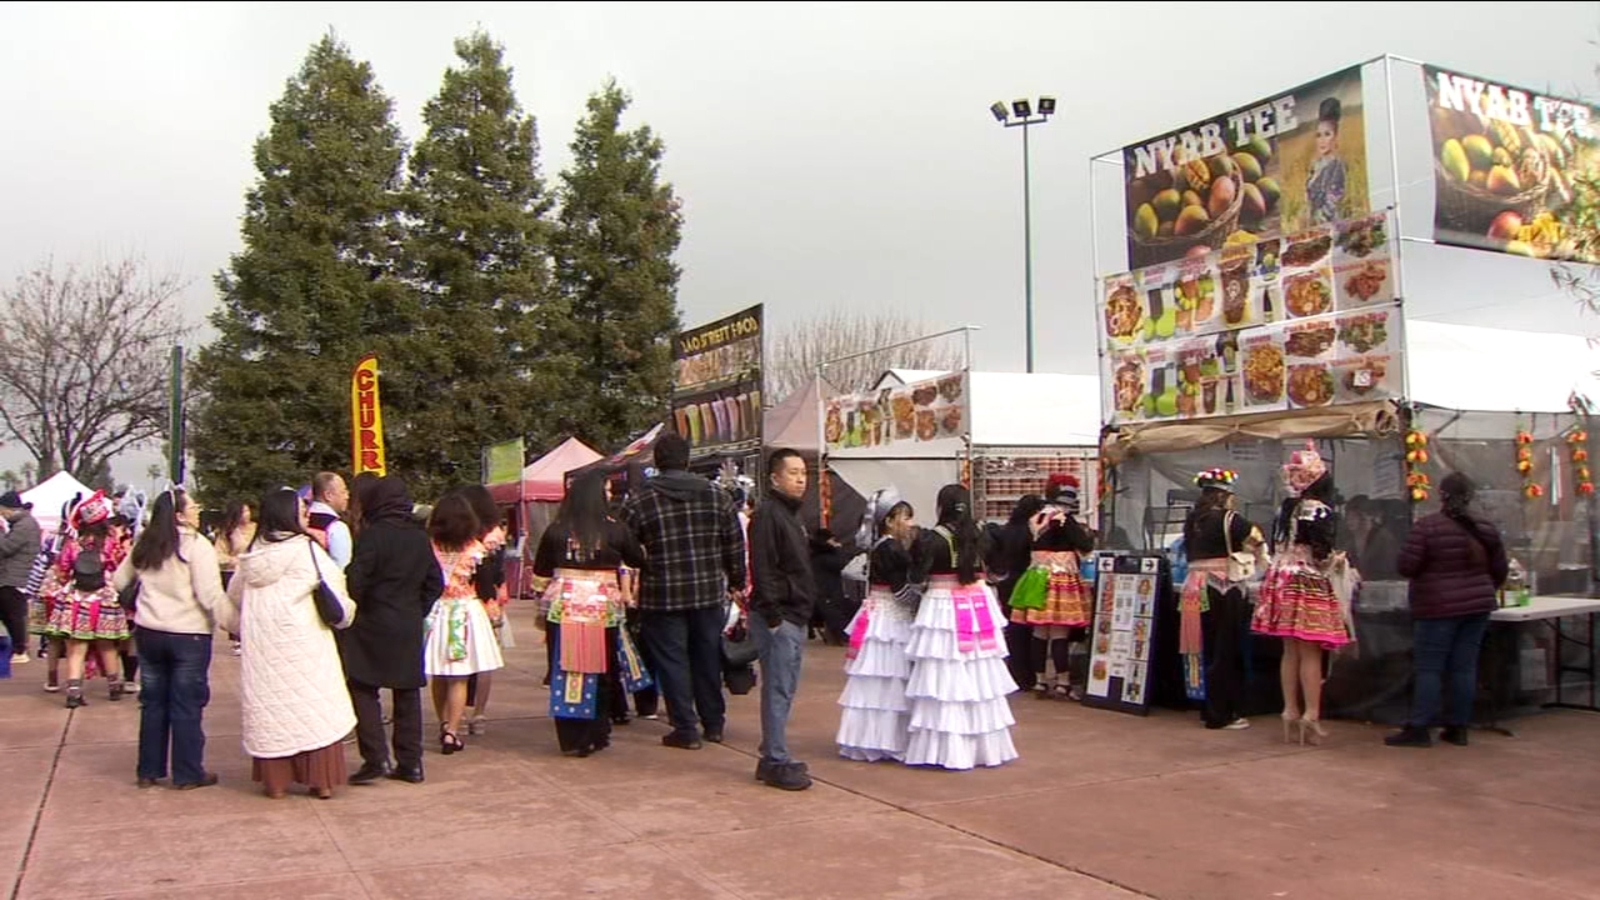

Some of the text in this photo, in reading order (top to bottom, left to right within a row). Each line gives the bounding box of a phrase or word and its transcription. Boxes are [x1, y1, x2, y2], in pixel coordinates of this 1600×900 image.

[1134, 95, 1298, 178] NYAB TEE
[1437, 72, 1594, 139] NYAB TEE
[700, 325, 730, 348] STREET
